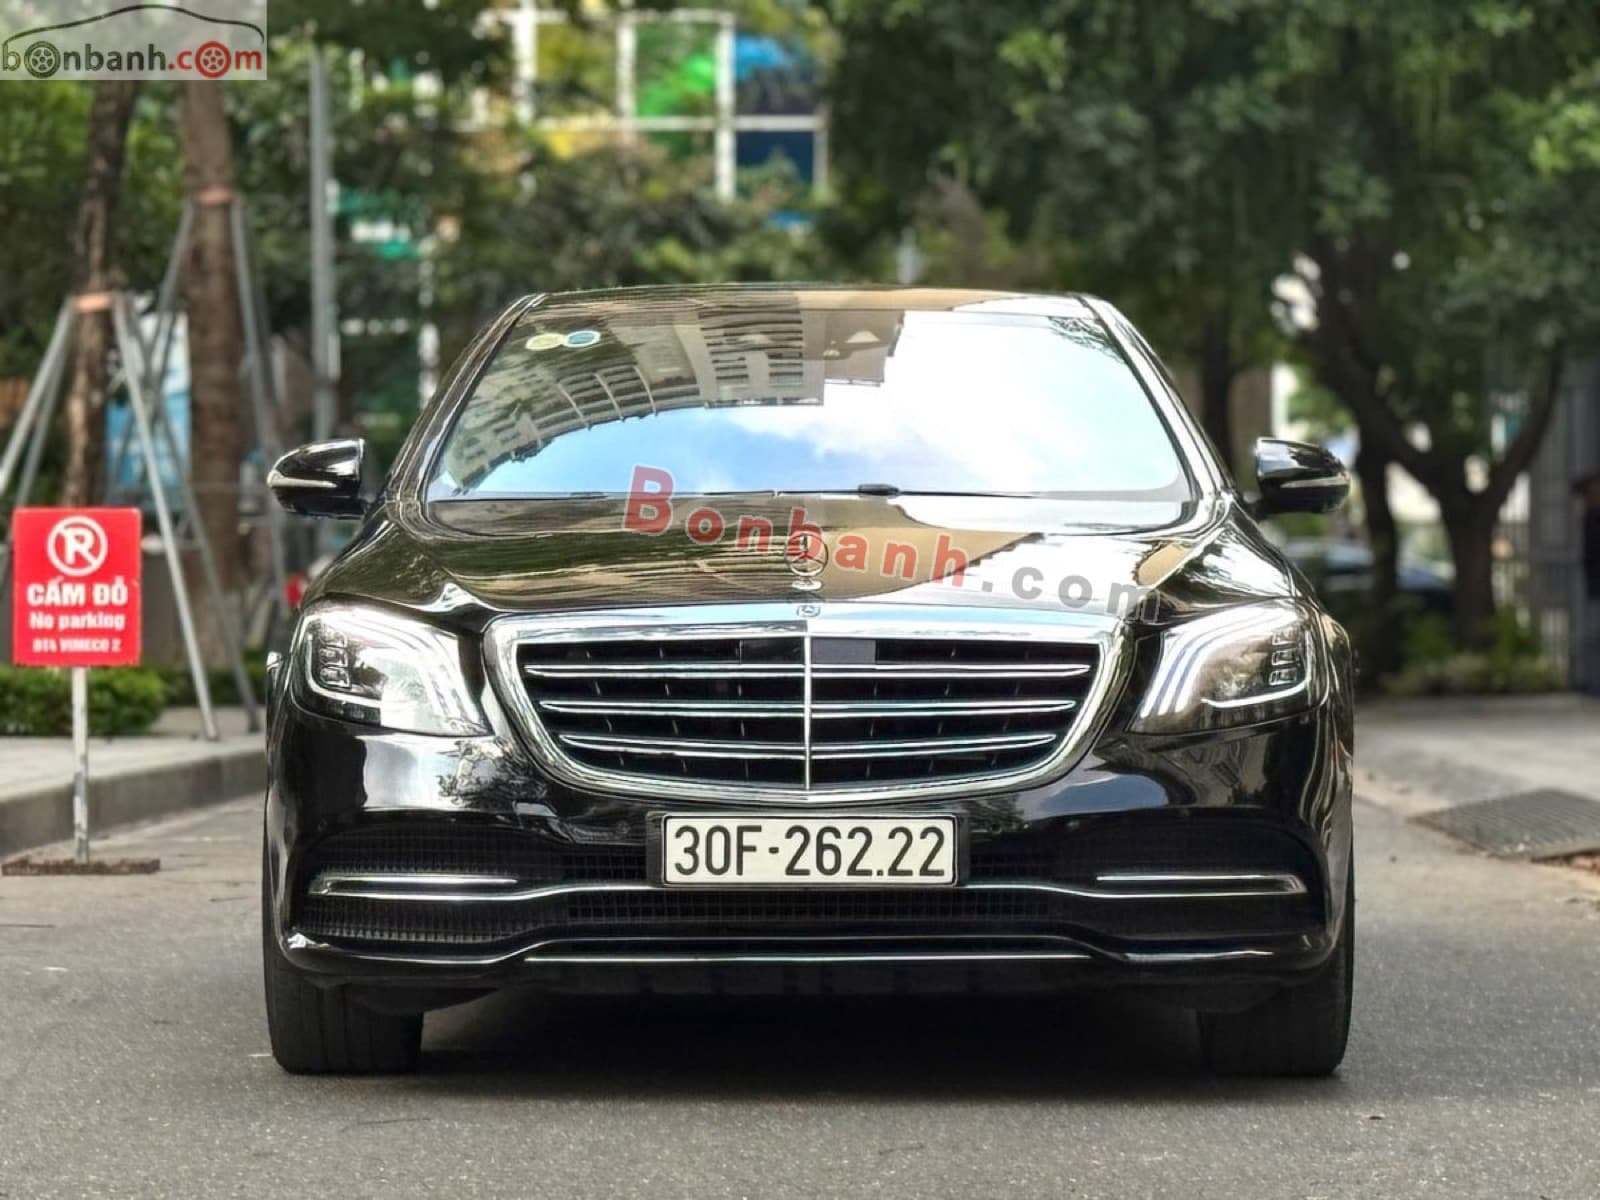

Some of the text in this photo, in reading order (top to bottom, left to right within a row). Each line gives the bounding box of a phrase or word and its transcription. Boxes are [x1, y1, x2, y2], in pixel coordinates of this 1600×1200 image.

[29, 612, 125, 632] No parking
[674, 824, 945, 877] 30F-262.22
